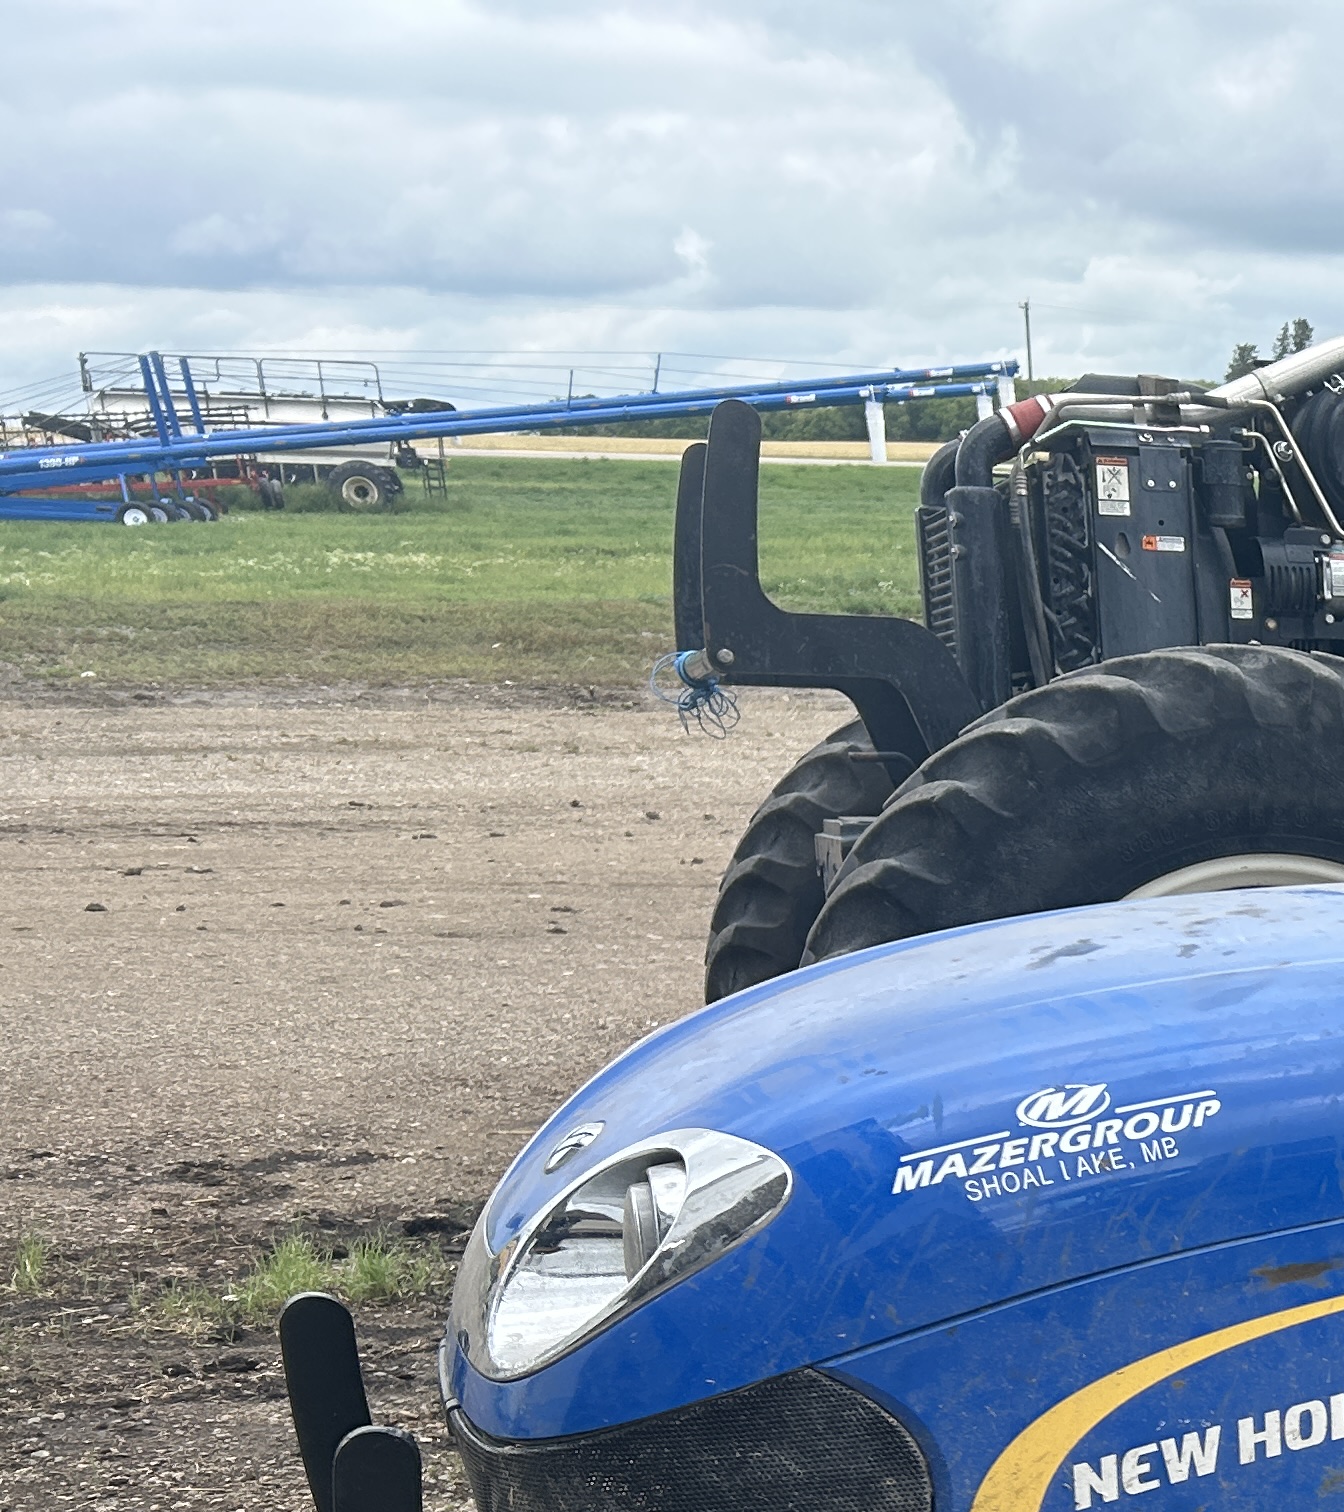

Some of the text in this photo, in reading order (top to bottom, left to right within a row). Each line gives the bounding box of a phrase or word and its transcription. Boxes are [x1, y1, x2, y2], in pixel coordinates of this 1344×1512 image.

[891, 1098, 1222, 1195] MAZERGROUP
[965, 1166, 1054, 1202] SHOAL
[1072, 1425, 1222, 1512] NEW
